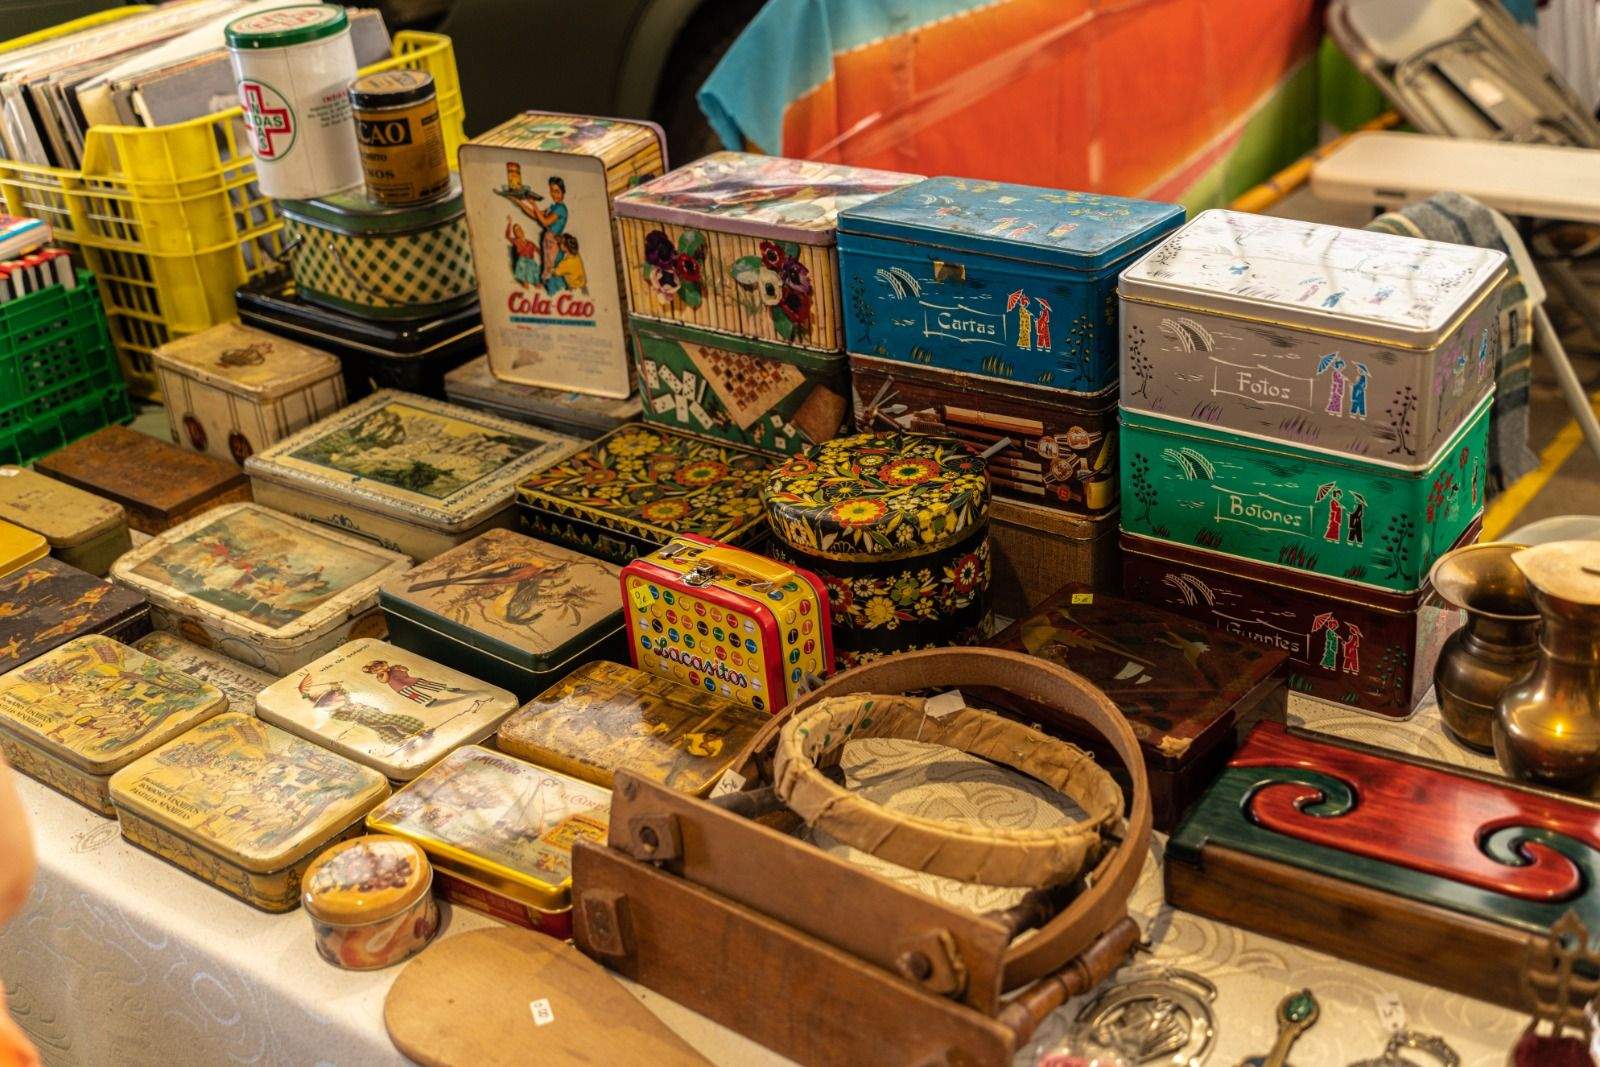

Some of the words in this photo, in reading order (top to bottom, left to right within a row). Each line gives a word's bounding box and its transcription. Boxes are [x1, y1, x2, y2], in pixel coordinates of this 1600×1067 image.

[507, 291, 552, 316] Cola
[556, 293, 595, 318] Cao
[937, 312, 995, 335] Cartas
[1236, 371, 1291, 399] Fotos
[653, 636, 748, 689] Lacasitos
